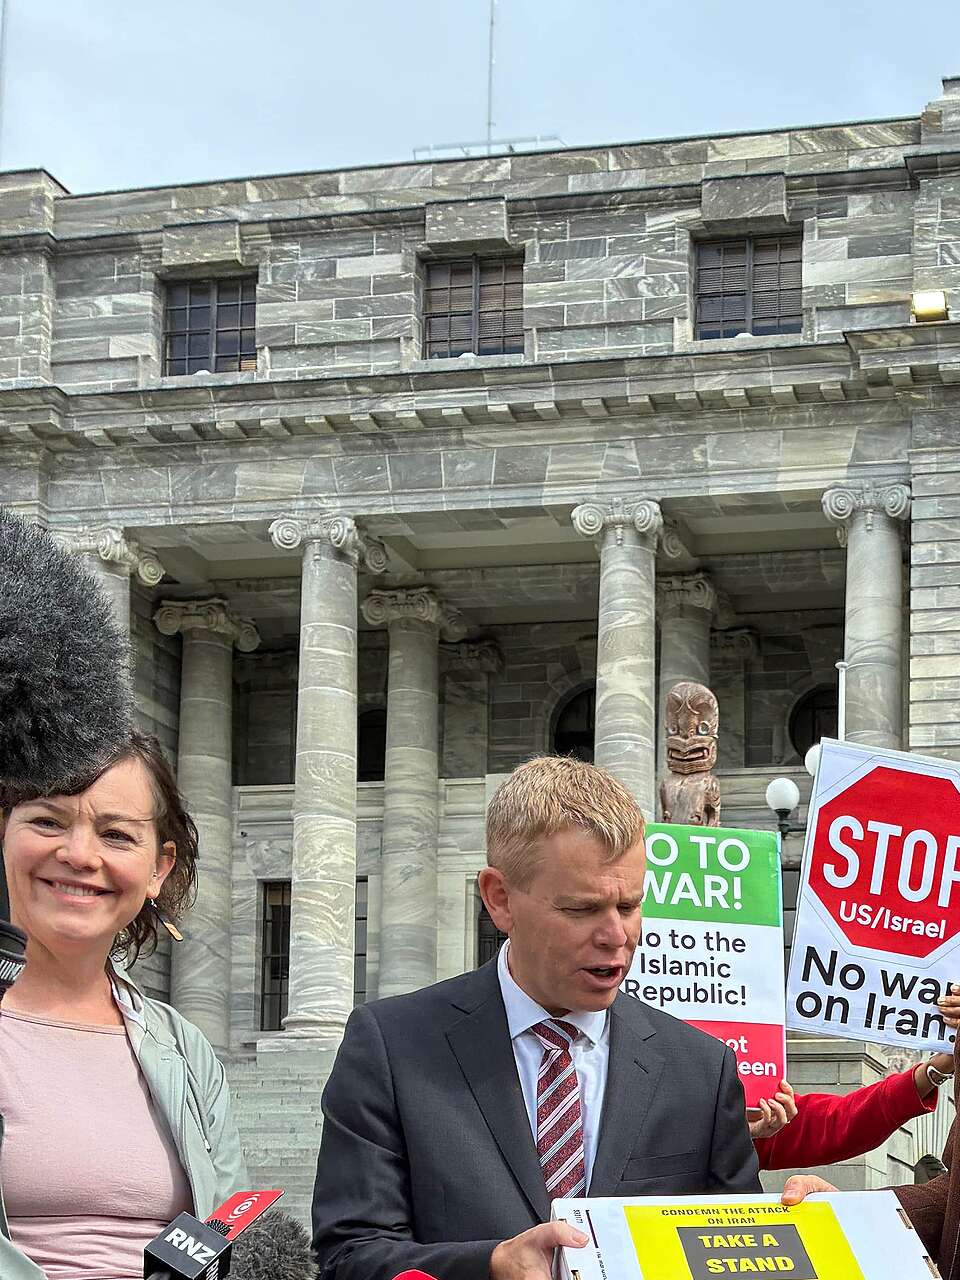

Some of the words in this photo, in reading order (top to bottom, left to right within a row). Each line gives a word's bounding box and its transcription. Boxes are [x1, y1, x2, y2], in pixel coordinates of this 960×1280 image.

[645, 832, 679, 867] O
[689, 835, 751, 872] TO
[640, 870, 743, 910] WAR!
[839, 901, 946, 939] US/Israel
[638, 932, 661, 948] o
[669, 929, 696, 949] to
[704, 931, 746, 952] the
[640, 953, 731, 978] Islamic
[802, 945, 866, 990] No
[624, 979, 747, 1007] Republic!
[795, 991, 850, 1024] on
[718, 1036, 748, 1054] ot
[737, 1061, 777, 1077] een
[661, 1208, 719, 1216] CONDEMN
[722, 1207, 746, 1215] THE
[748, 1206, 791, 1214] ATTACK
[707, 1217, 724, 1225] ON
[164, 1227, 217, 1266] RNZ
[698, 1234, 758, 1249] TAKE
[762, 1233, 780, 1247] A
[705, 1256, 795, 1274] STAND
